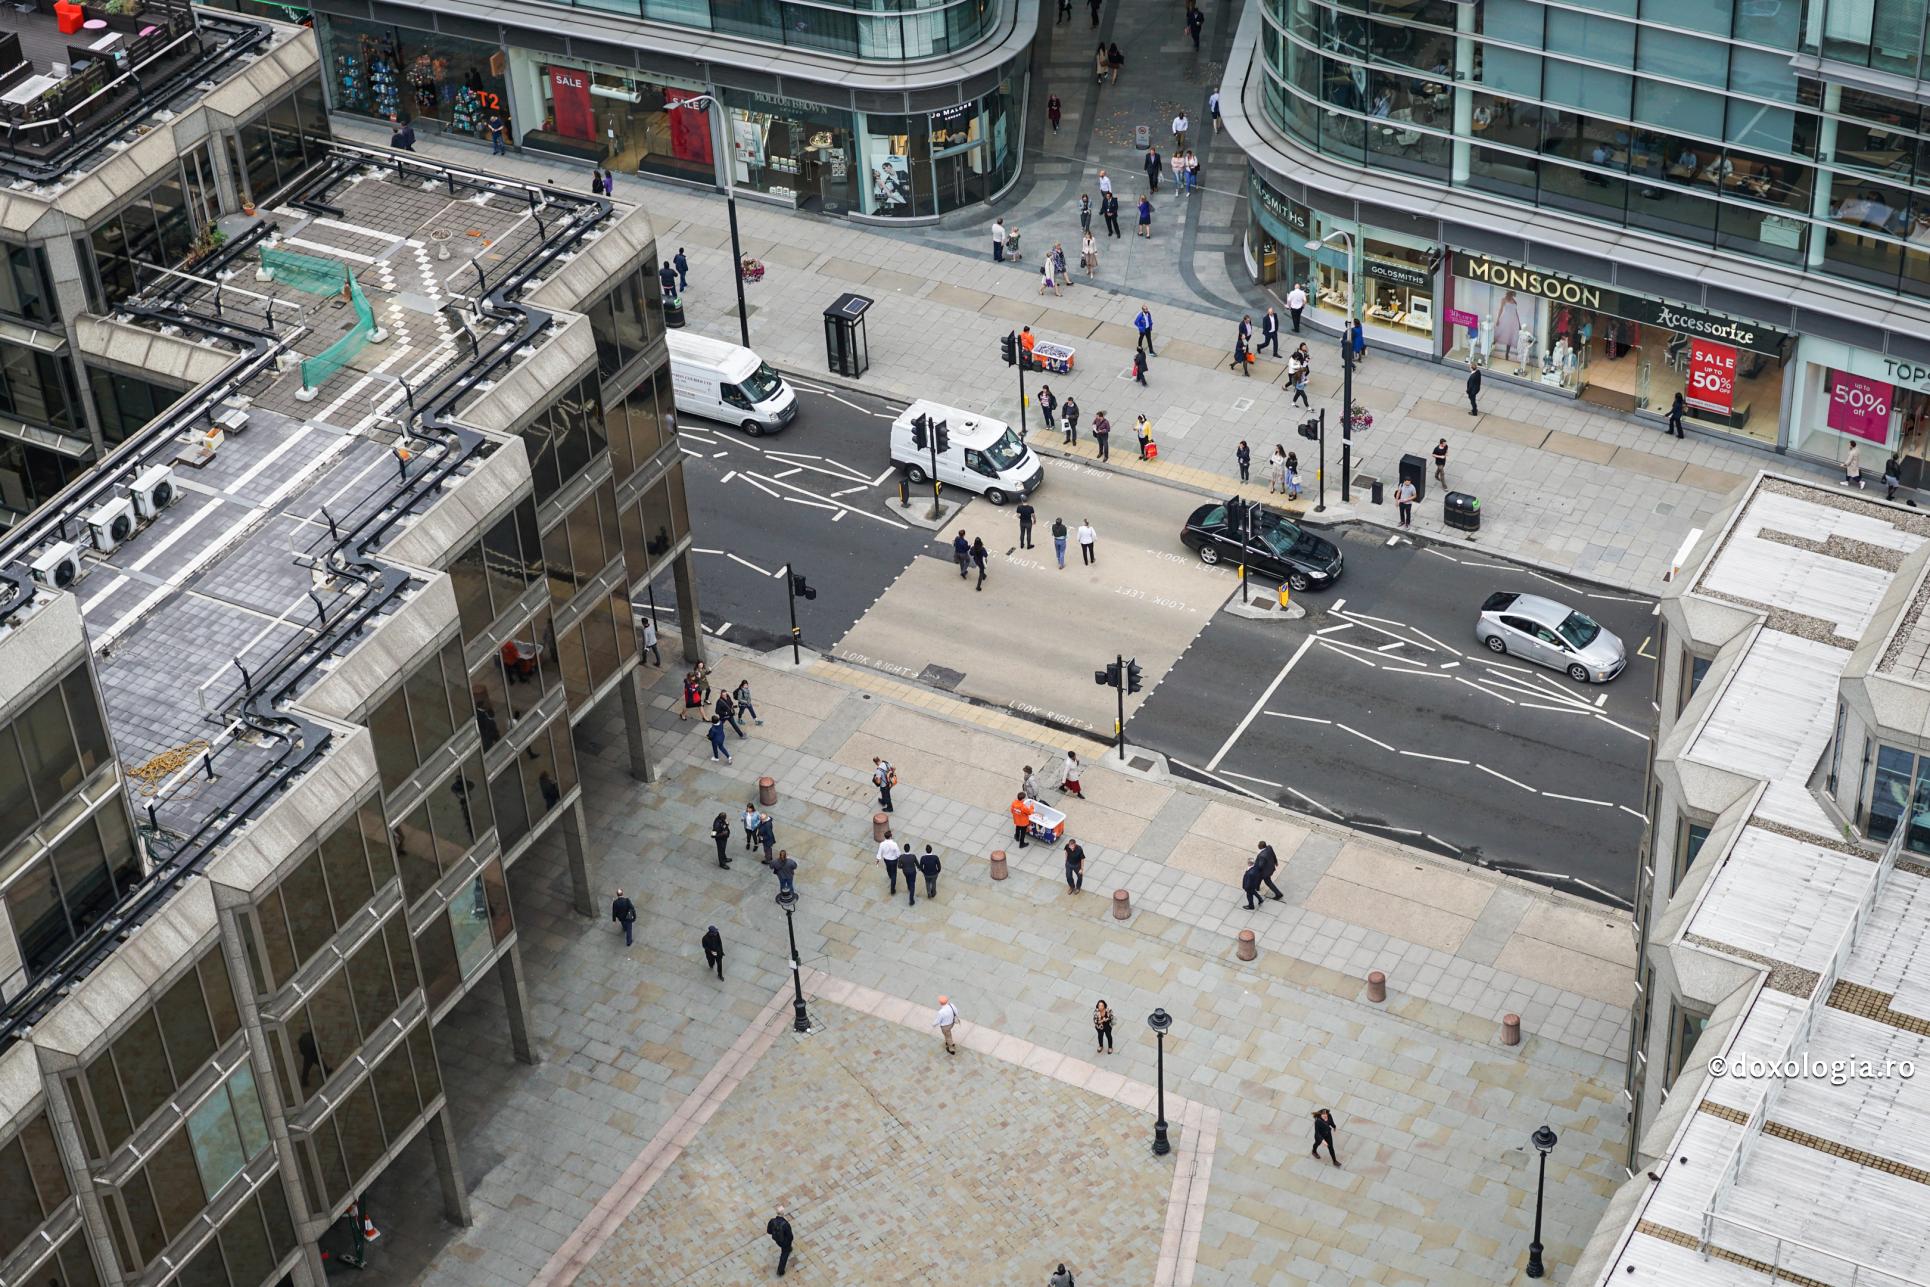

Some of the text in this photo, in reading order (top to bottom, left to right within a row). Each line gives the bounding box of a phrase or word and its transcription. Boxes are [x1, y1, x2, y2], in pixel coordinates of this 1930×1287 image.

[556, 75, 582, 88] SALE
[476, 90, 500, 110] T2
[754, 90, 790, 107] MOLTON
[792, 99, 828, 115] BROWN
[1371, 265, 1424, 285] GOLDSMITHS
[1468, 259, 1600, 309] MONSOON
[1656, 306, 1754, 344] Accessorize
[1695, 350, 1734, 369] SALE
[1692, 370, 1732, 391] 50%
[1714, 368, 1723, 376] TO
[1884, 358, 1930, 383] TOP
[1719, 387, 1731, 395] OFF
[1854, 382, 1871, 392] up to
[1834, 384, 1887, 416] 50%
[1853, 408, 1866, 417] off
[1048, 459, 1114, 480] LOOK RIGHT
[1155, 551, 1230, 577] LOOK LEFT
[1114, 586, 1186, 611] LOOK LEFT
[841, 649, 912, 676] LOOK RIGHT
[1008, 699, 1084, 728] LOOK RIGHT
